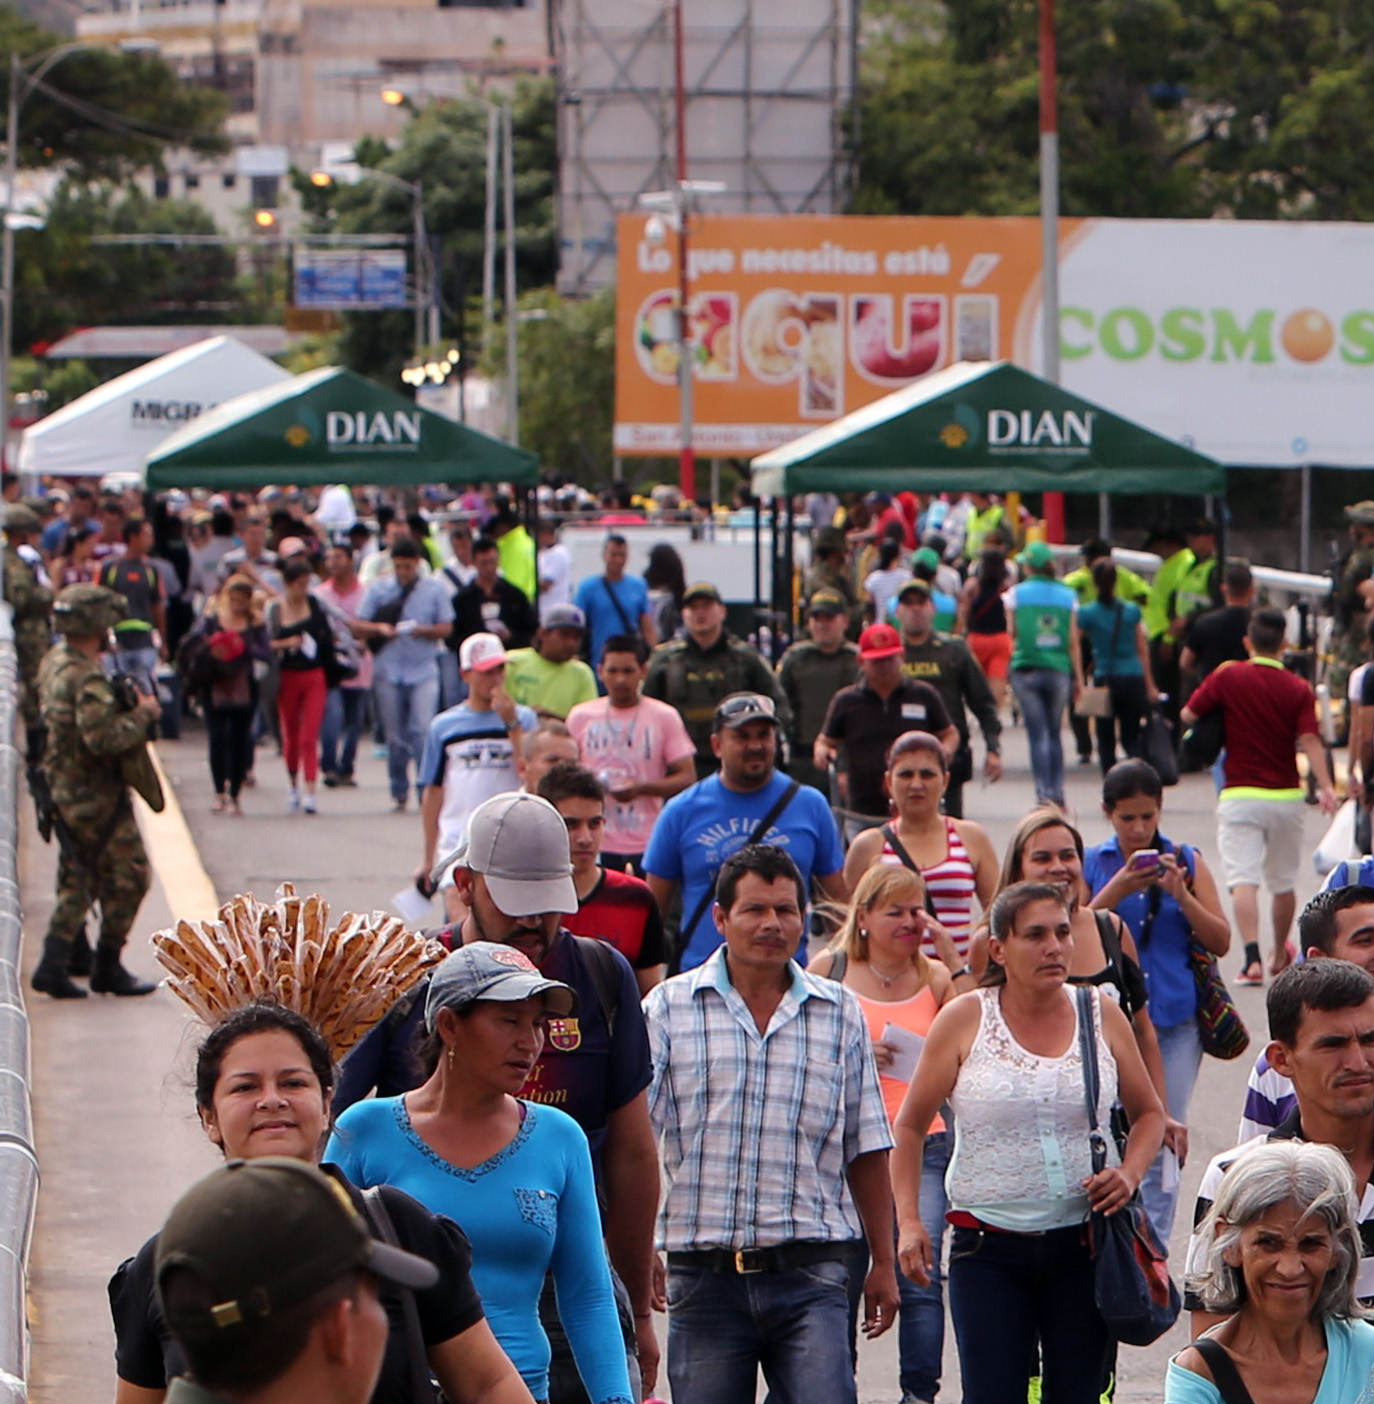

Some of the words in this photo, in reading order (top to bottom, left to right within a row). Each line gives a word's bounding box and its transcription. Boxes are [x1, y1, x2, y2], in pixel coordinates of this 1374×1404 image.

[637, 243, 671, 273] Lo
[741, 242, 879, 276] necesitas
[884, 243, 951, 275] está
[633, 253, 1002, 419] aquí
[131, 400, 218, 421] MIGR
[326, 411, 421, 444] DIAN
[986, 409, 1093, 446] DIAN
